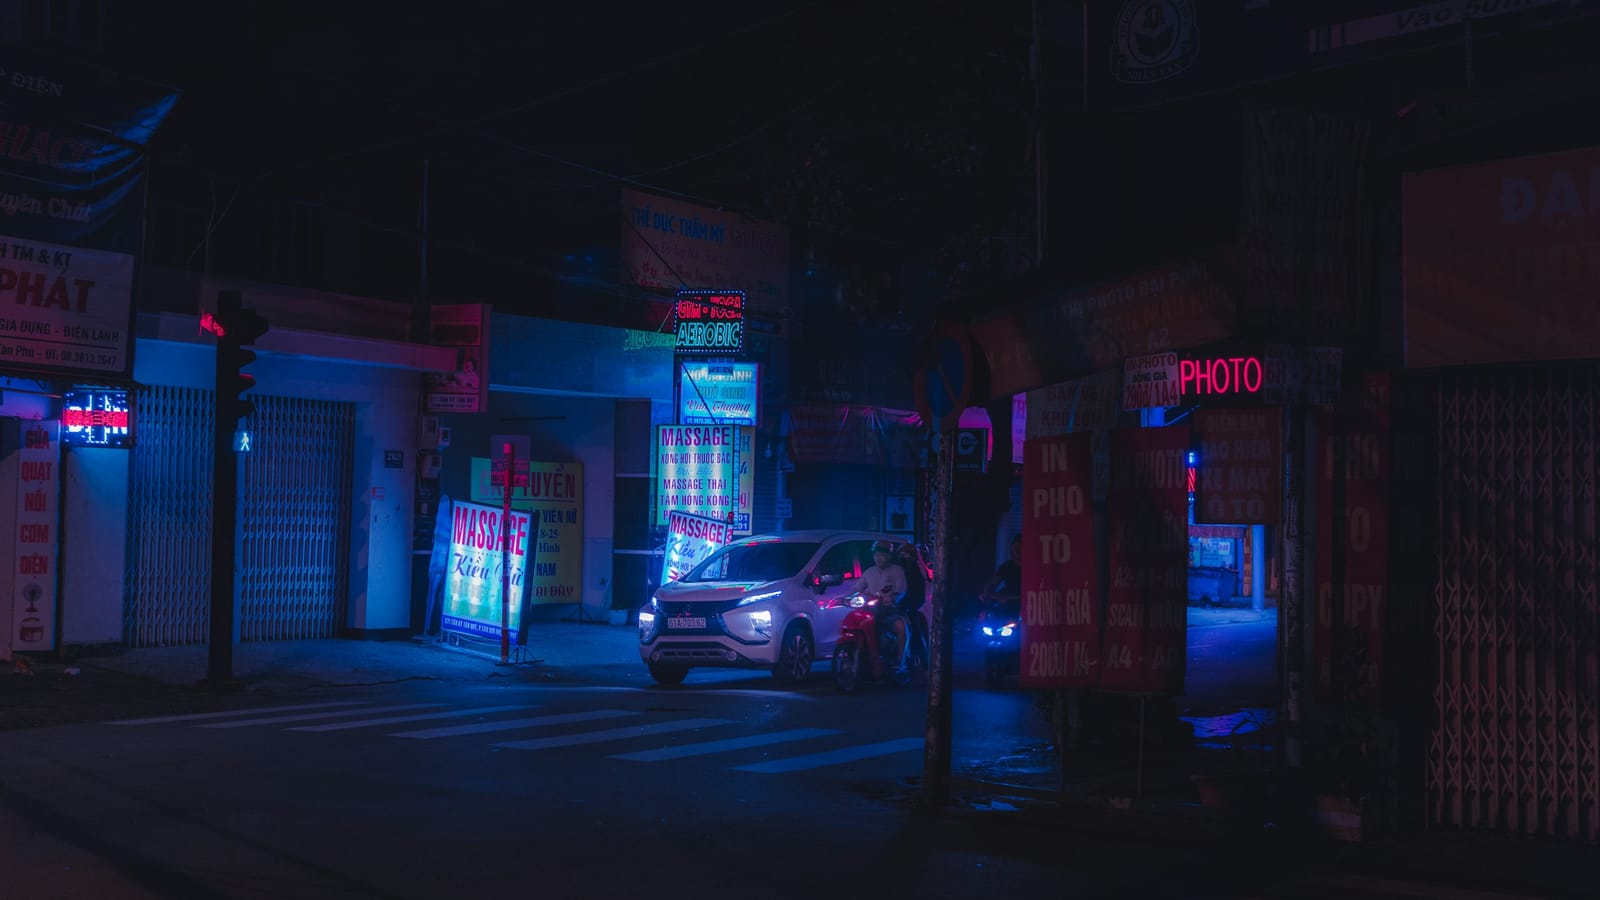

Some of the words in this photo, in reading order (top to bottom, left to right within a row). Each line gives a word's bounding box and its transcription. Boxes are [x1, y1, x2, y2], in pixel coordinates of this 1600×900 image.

[13, 244, 34, 261] TM
[38, 248, 49, 264] &
[54, 251, 72, 267] KT
[0, 268, 96, 313] PHÁT
[676, 322, 740, 346] AEROBIC
[1180, 357, 1263, 395] PHOTO
[661, 427, 731, 447] MASSAGE
[1041, 442, 1068, 472] IN
[663, 479, 703, 490] MASSAGE
[1033, 485, 1085, 518] PHO
[453, 506, 528, 556] MASSAGE
[669, 514, 724, 545] MASSAGE
[1040, 534, 1072, 566] TO
[449, 552, 489, 580] Kiều
[536, 563, 557, 577] NAM
[1066, 580, 1092, 626] GIÁ
